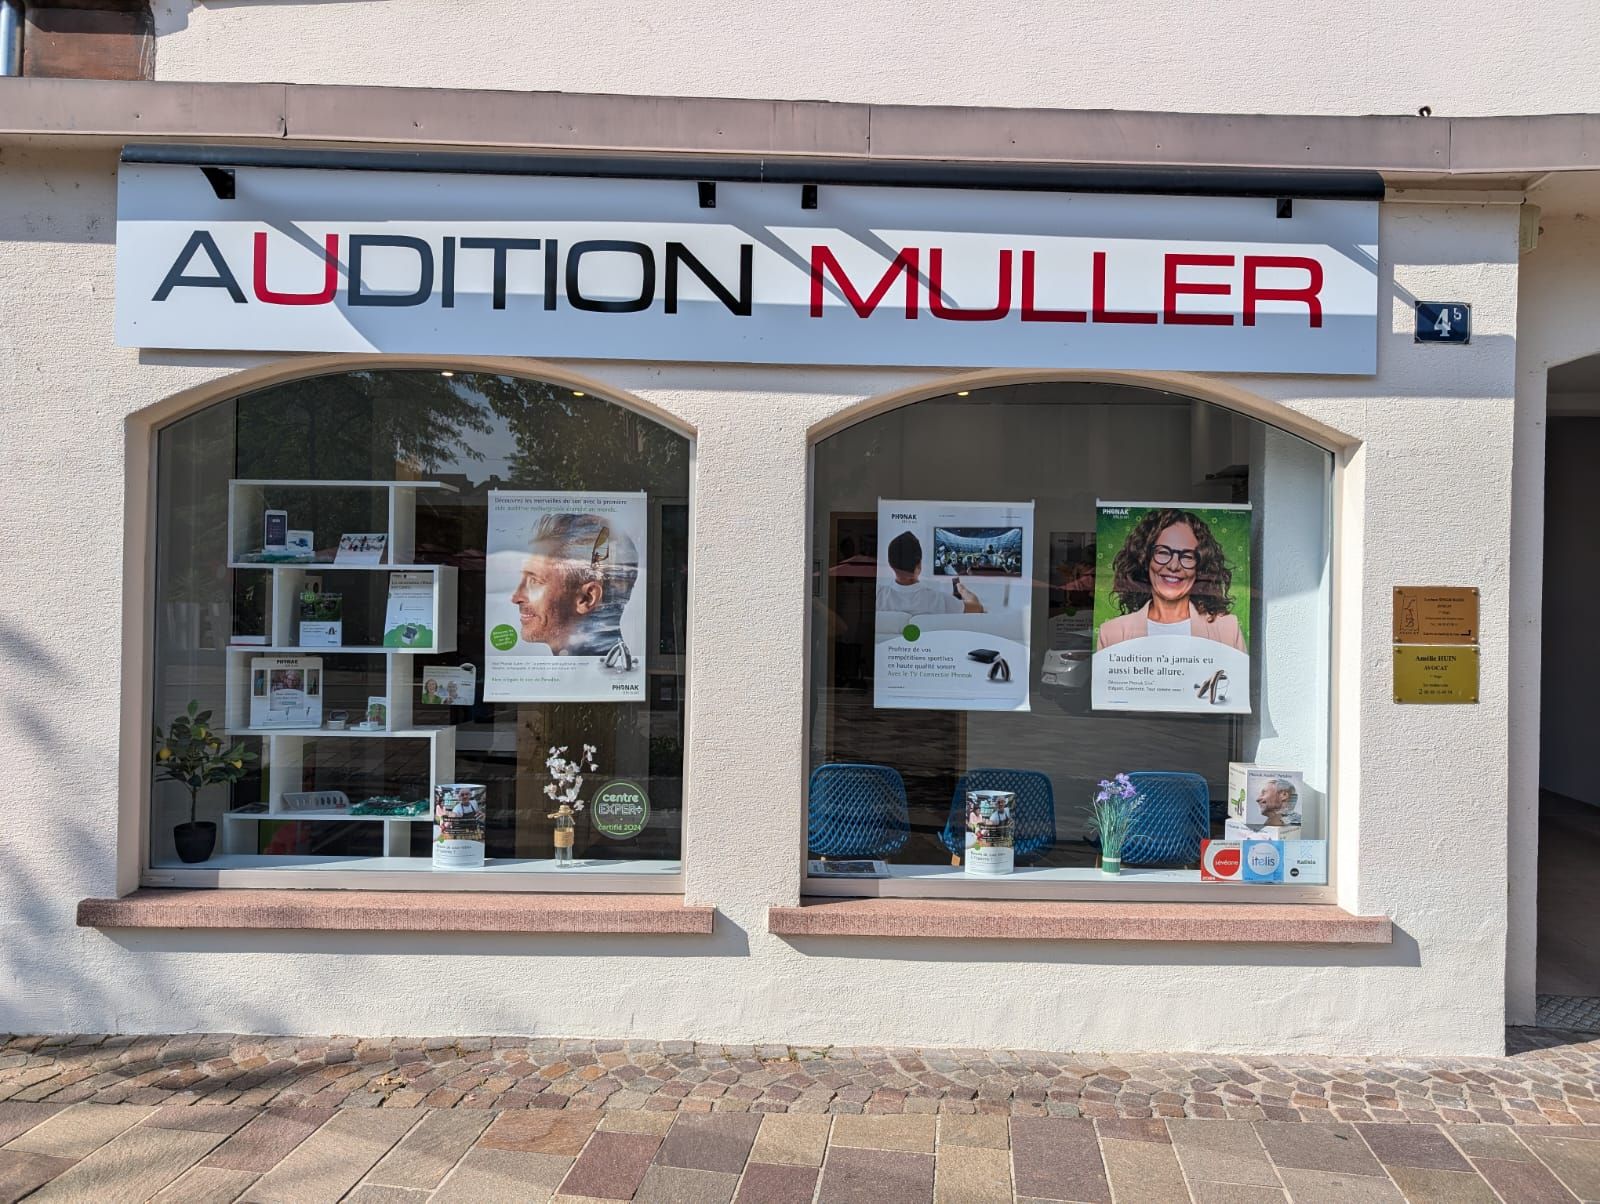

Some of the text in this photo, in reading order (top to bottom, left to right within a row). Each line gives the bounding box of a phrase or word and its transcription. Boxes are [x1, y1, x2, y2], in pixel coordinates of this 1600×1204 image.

[151, 229, 1325, 328] AUDITION MULLER
[1109, 654, 1153, 663] L'audition
[1156, 655, 1169, 663] n'a
[1171, 656, 1200, 666] jamais
[1133, 667, 1154, 675] belle
[1157, 668, 1185, 676] allure.
[602, 793, 639, 803] centre
[1251, 856, 1275, 866] itelis
